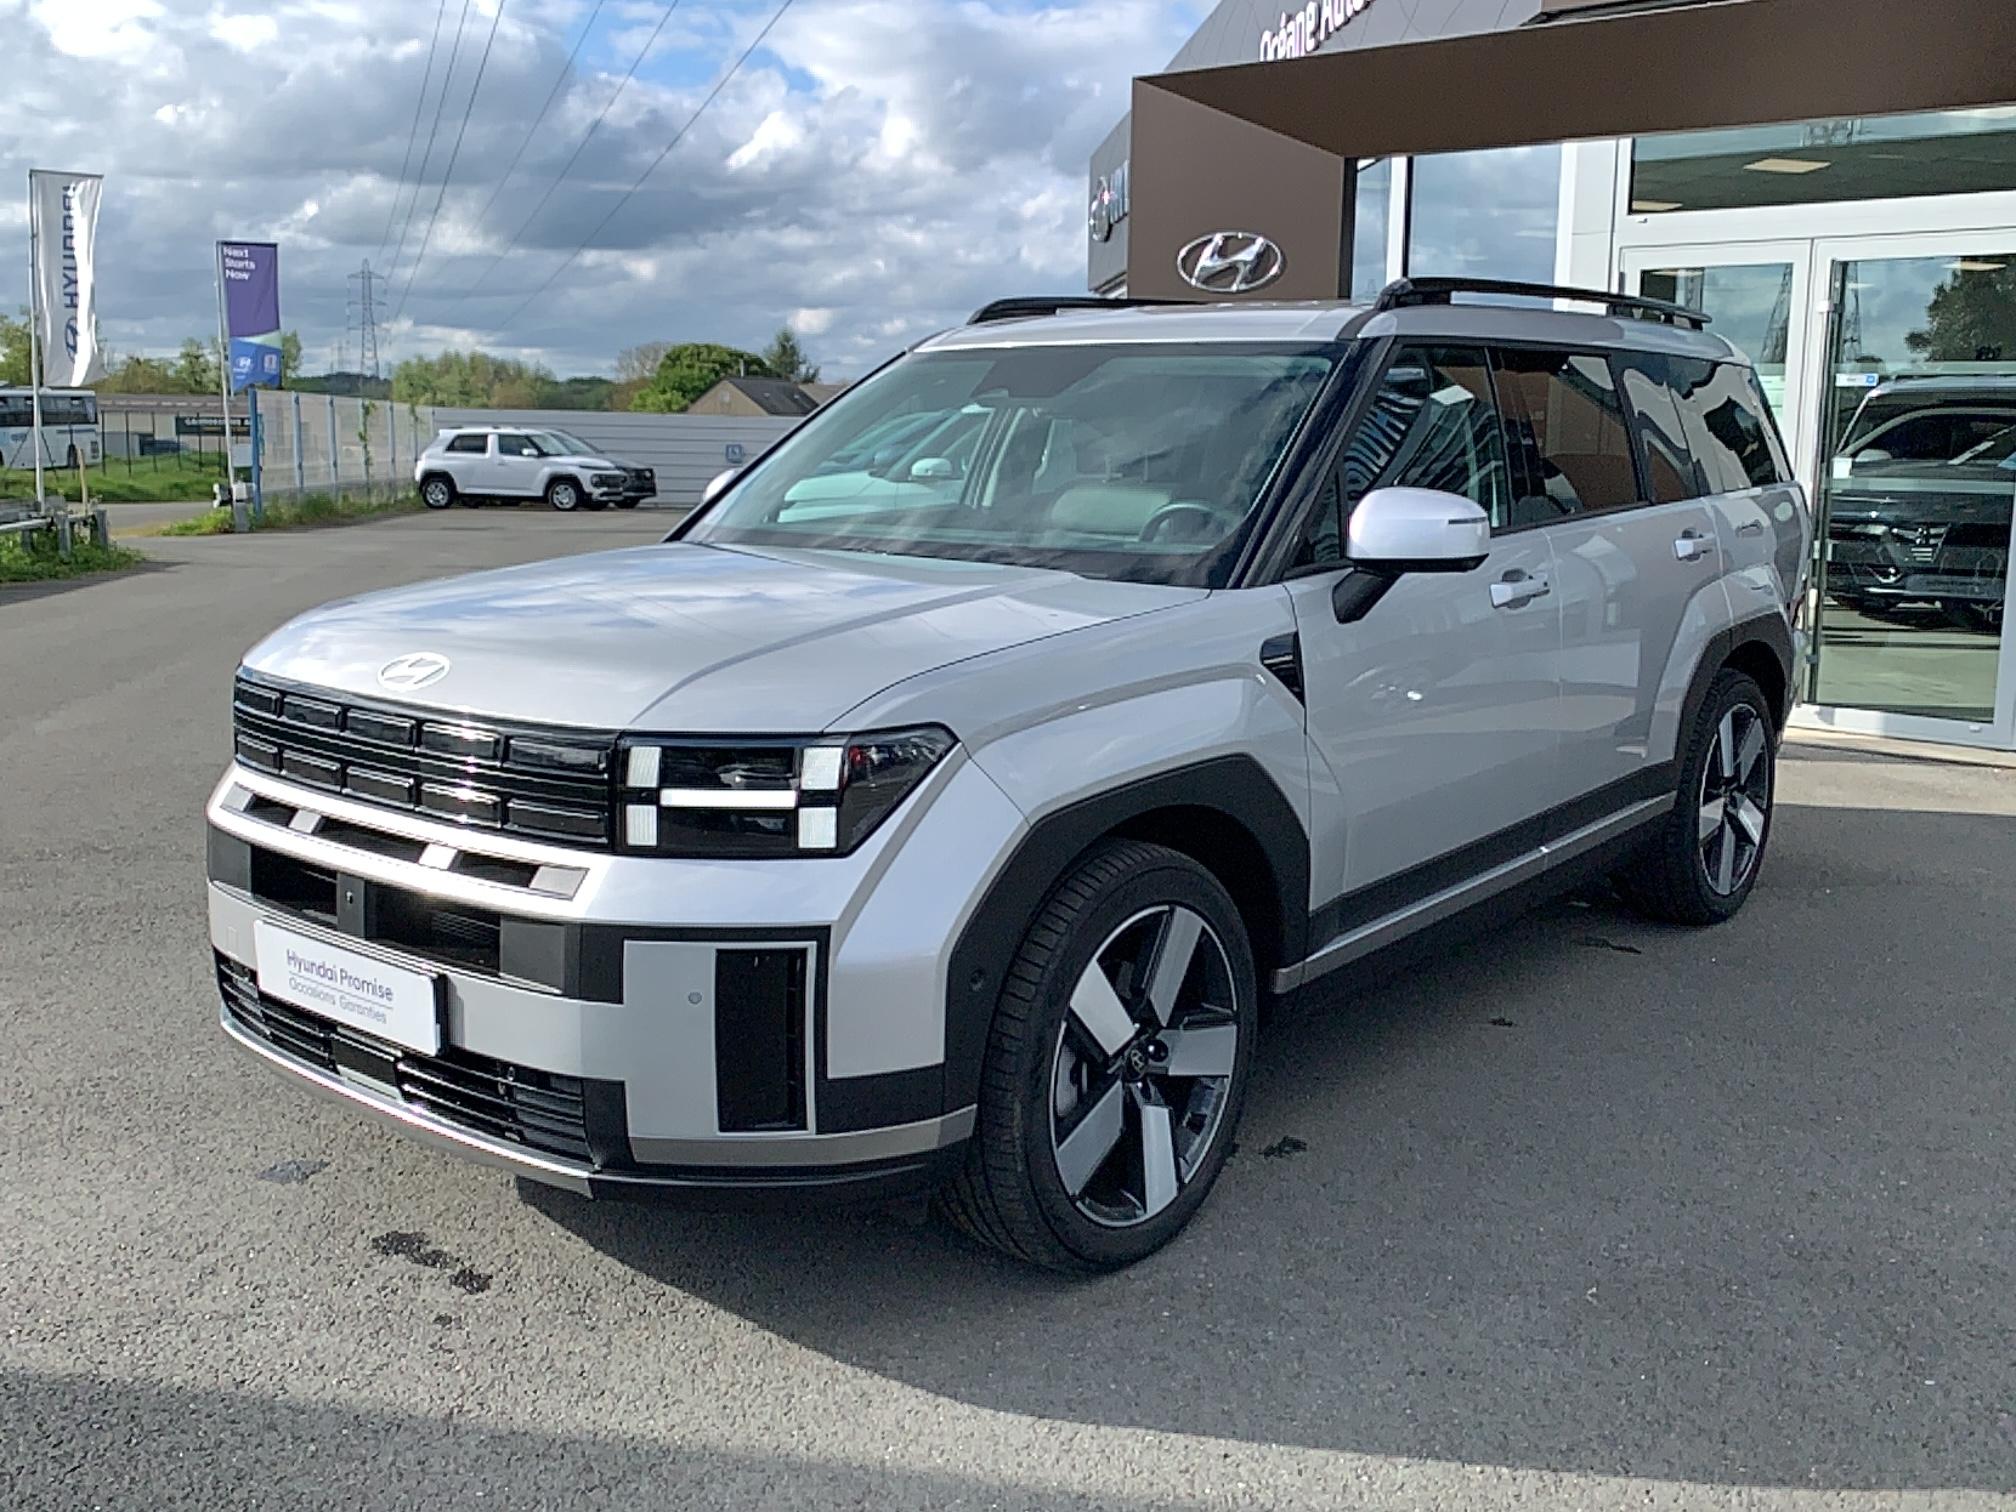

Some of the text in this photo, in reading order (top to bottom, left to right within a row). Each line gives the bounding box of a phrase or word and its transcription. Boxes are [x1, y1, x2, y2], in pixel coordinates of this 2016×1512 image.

[225, 269, 250, 281] Now
[286, 948, 394, 1002] Hyundai Promise
